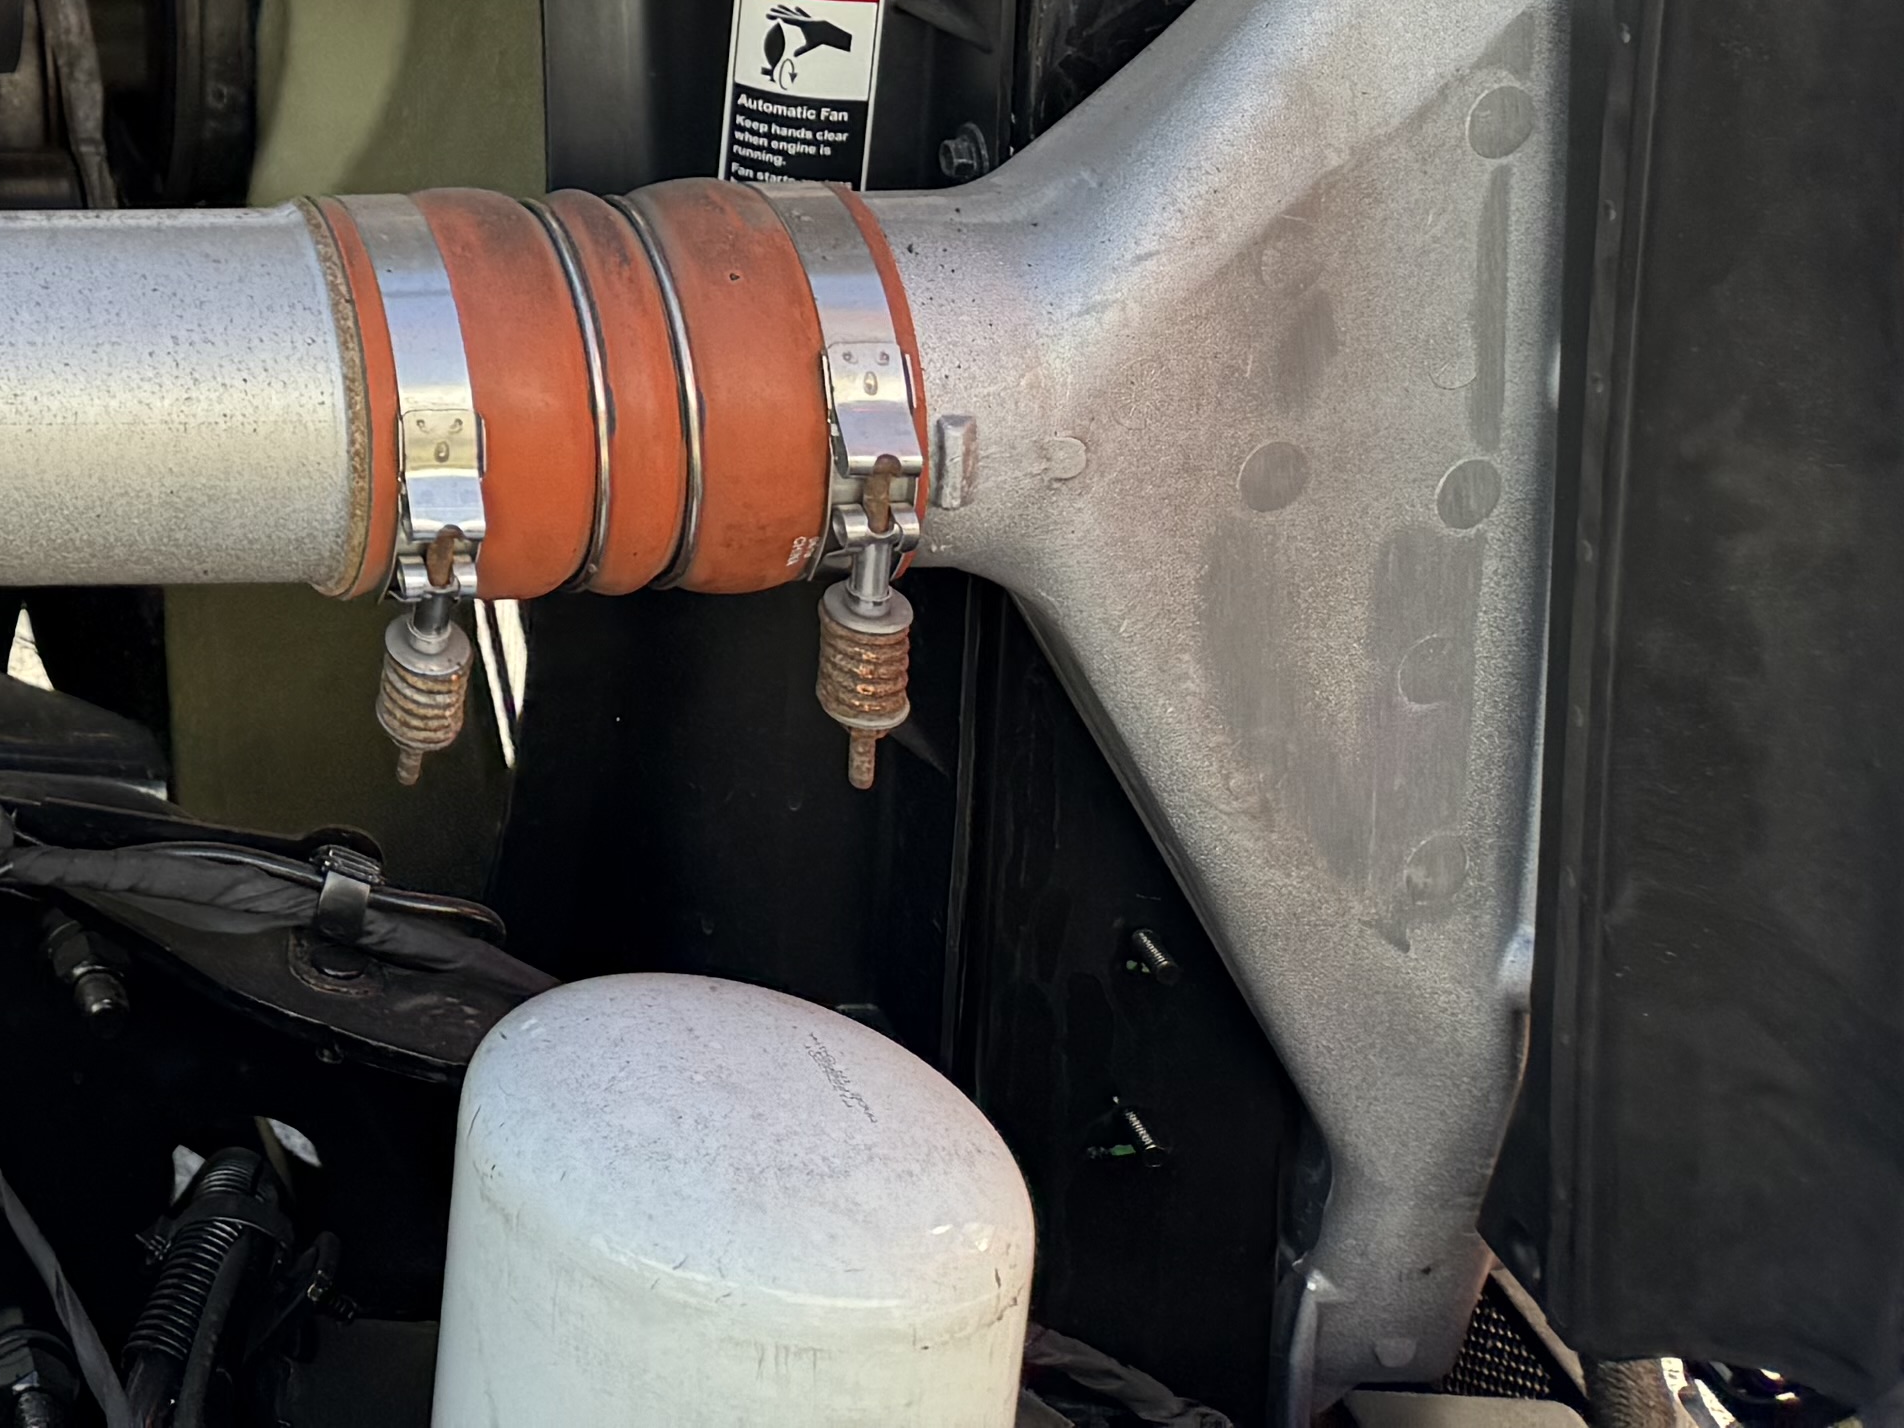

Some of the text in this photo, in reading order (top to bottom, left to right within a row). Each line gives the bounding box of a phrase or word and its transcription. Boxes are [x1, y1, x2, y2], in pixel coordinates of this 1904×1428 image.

[737, 93, 849, 122] Automatic Fan
[735, 114, 849, 142] Keep hands clear
[733, 144, 786, 167] running.
[734, 130, 831, 156] when engine is
[732, 161, 753, 179] Fan
